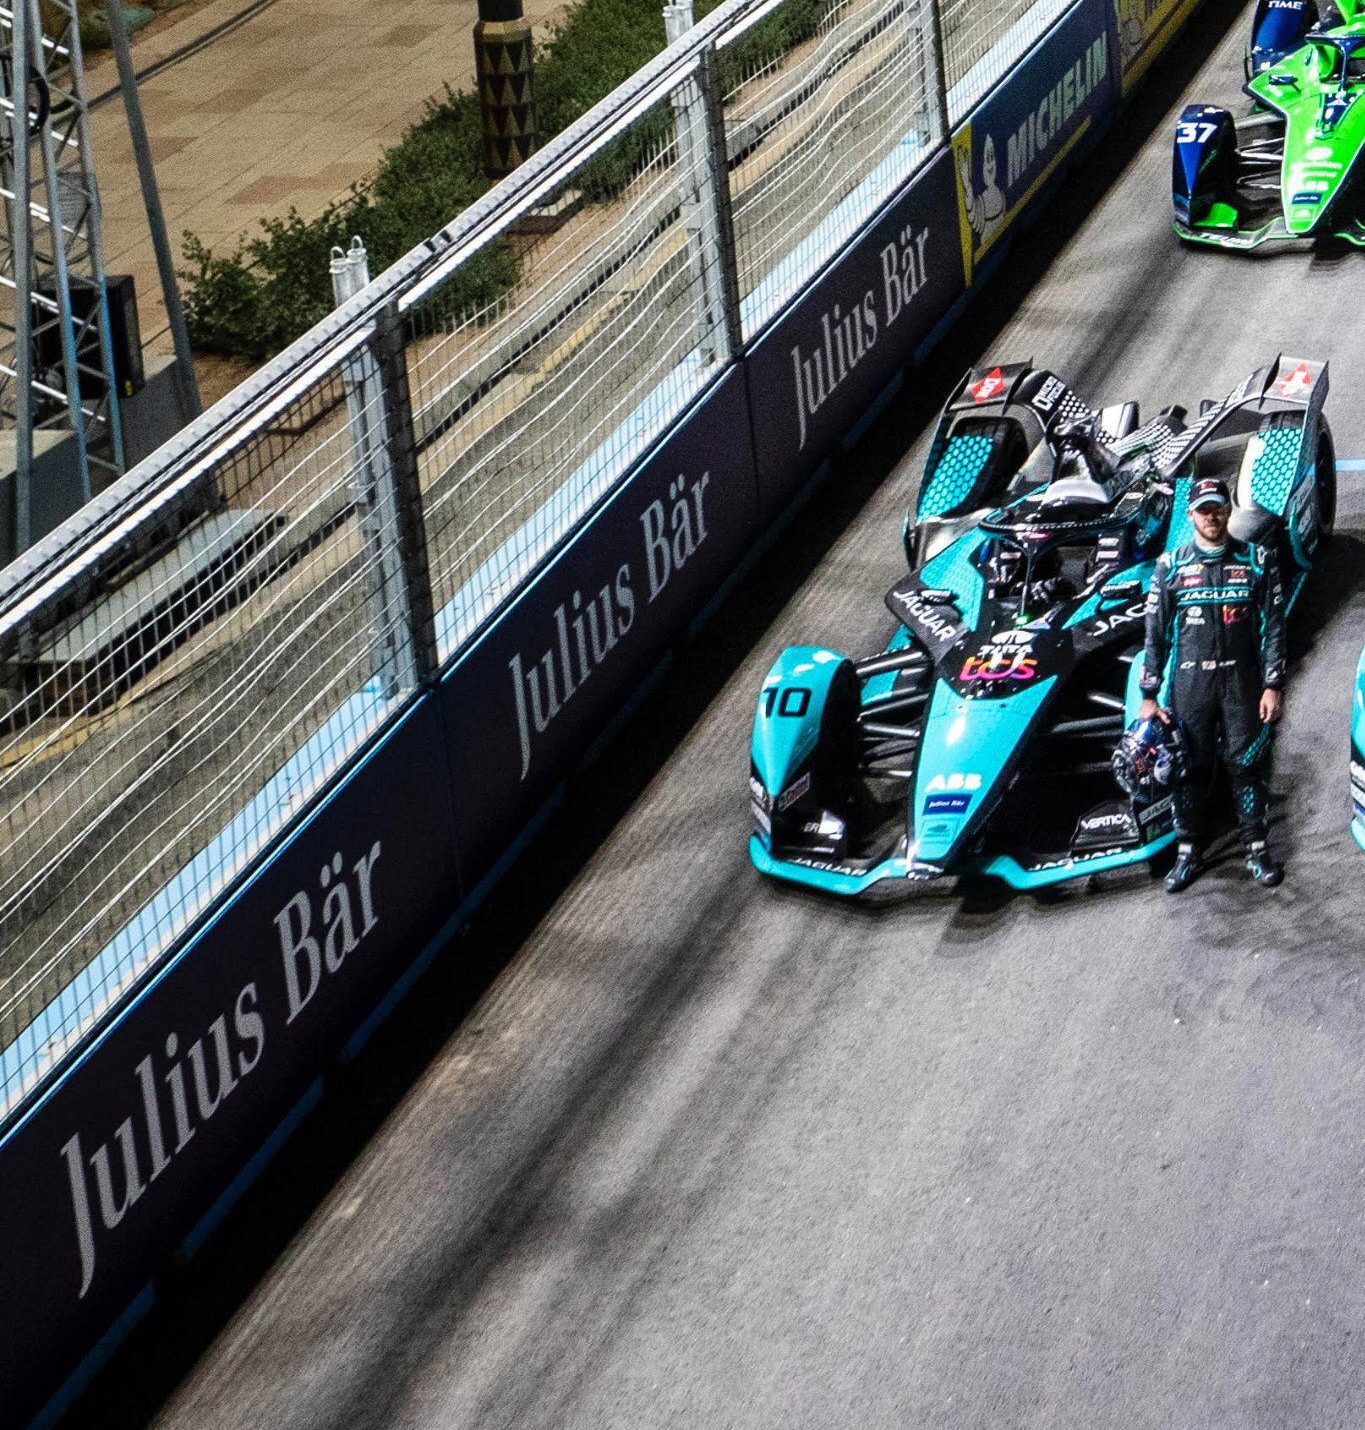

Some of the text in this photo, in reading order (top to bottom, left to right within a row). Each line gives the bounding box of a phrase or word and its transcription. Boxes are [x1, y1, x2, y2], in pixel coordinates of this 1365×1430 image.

[1006, 32, 1111, 173] MICHELIN
[1176, 123, 1217, 144] 37
[790, 224, 930, 450] Julius Bär
[1180, 589, 1250, 602] JAGUAR
[507, 469, 711, 781] Julius Bär
[893, 590, 957, 642] JAGUAR
[762, 686, 812, 719] 10
[924, 773, 983, 792] ABB
[1081, 813, 1132, 831] VERTICA
[791, 857, 867, 876] JAGUAR
[59, 839, 382, 1300] Julius Bär
